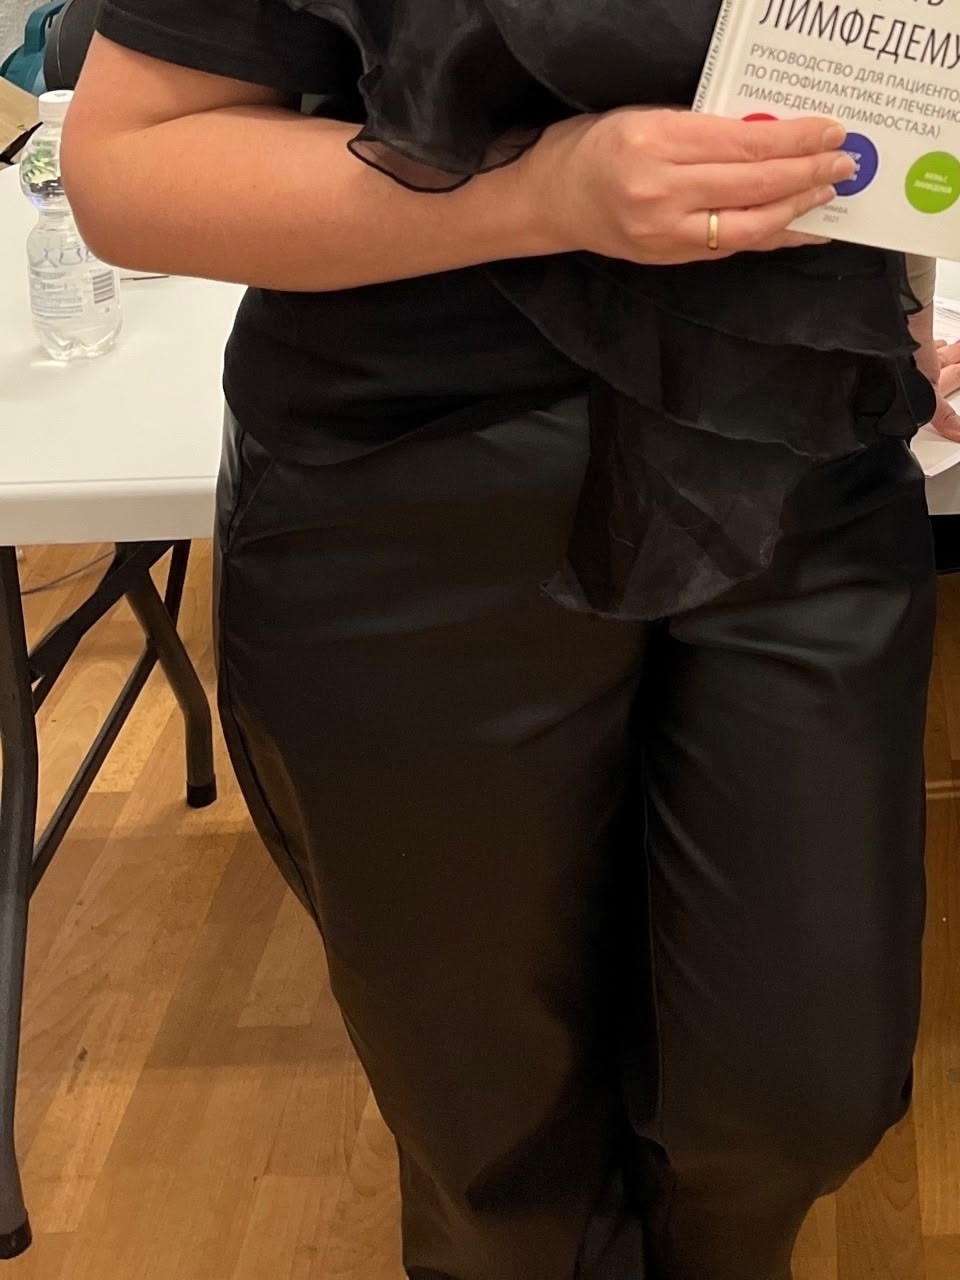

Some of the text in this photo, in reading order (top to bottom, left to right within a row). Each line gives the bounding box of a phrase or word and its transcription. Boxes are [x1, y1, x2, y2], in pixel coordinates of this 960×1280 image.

[744, 63, 767, 79] ПО
[769, 69, 882, 106] ПРОФИЛАКТИКЕ
[885, 96, 896, 108] И
[750, 43, 853, 78] РУКОВОДСТВО
[854, 68, 884, 85] ДЛЯ
[738, 84, 941, 139] ЛИМФЕДЕМЫ (ЛИМФОСТАЗА)
